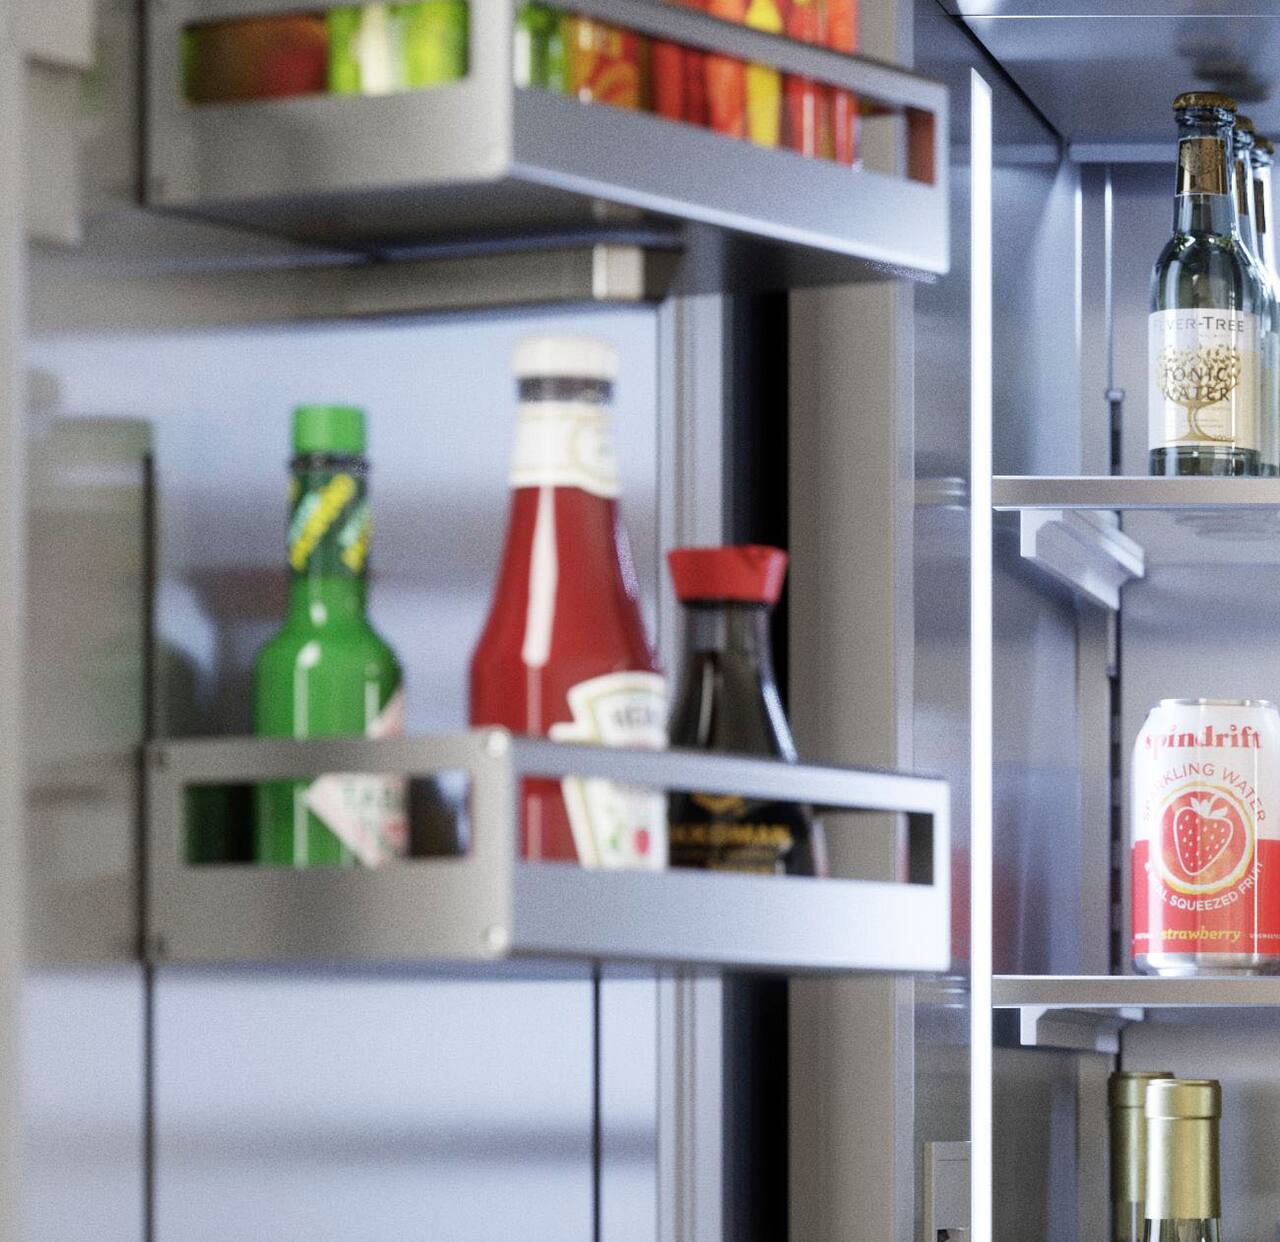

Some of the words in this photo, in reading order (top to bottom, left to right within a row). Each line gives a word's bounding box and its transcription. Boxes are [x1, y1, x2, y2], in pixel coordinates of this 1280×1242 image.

[1164, 367, 1229, 383] TONIC
[1162, 386, 1231, 402] WATER
[1145, 724, 1262, 761] spindrift
[1222, 767, 1266, 821] WATER
[1170, 889, 1239, 912] SQUEEZED
[1160, 925, 1240, 943] strawberry
